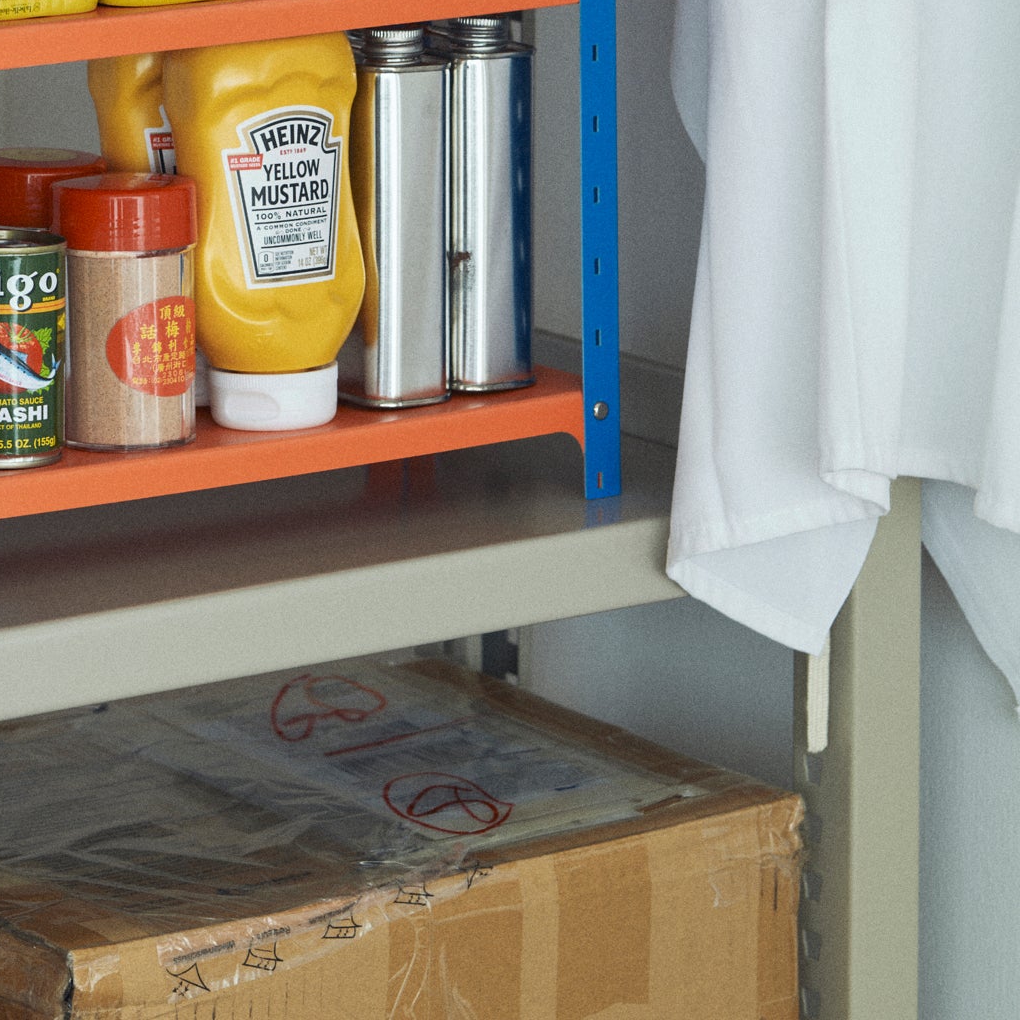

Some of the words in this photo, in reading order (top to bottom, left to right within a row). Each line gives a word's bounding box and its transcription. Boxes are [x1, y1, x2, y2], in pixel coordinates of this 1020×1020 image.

[260, 123, 321, 152] HEINZ
[239, 155, 261, 163] GRADE
[263, 158, 320, 182] YELLOW
[251, 179, 329, 207] MUSTARD
[256, 211, 282, 221] 100%
[285, 206, 327, 218] NATURAL
[263, 223, 294, 231] COMMON
[295, 218, 327, 227] CONDIMENT
[263, 232, 306, 246] UNCOMMONLY
[307, 229, 323, 241] WELL
[19, 396, 44, 405] SAUCE
[15, 438, 32, 448] OZ.
